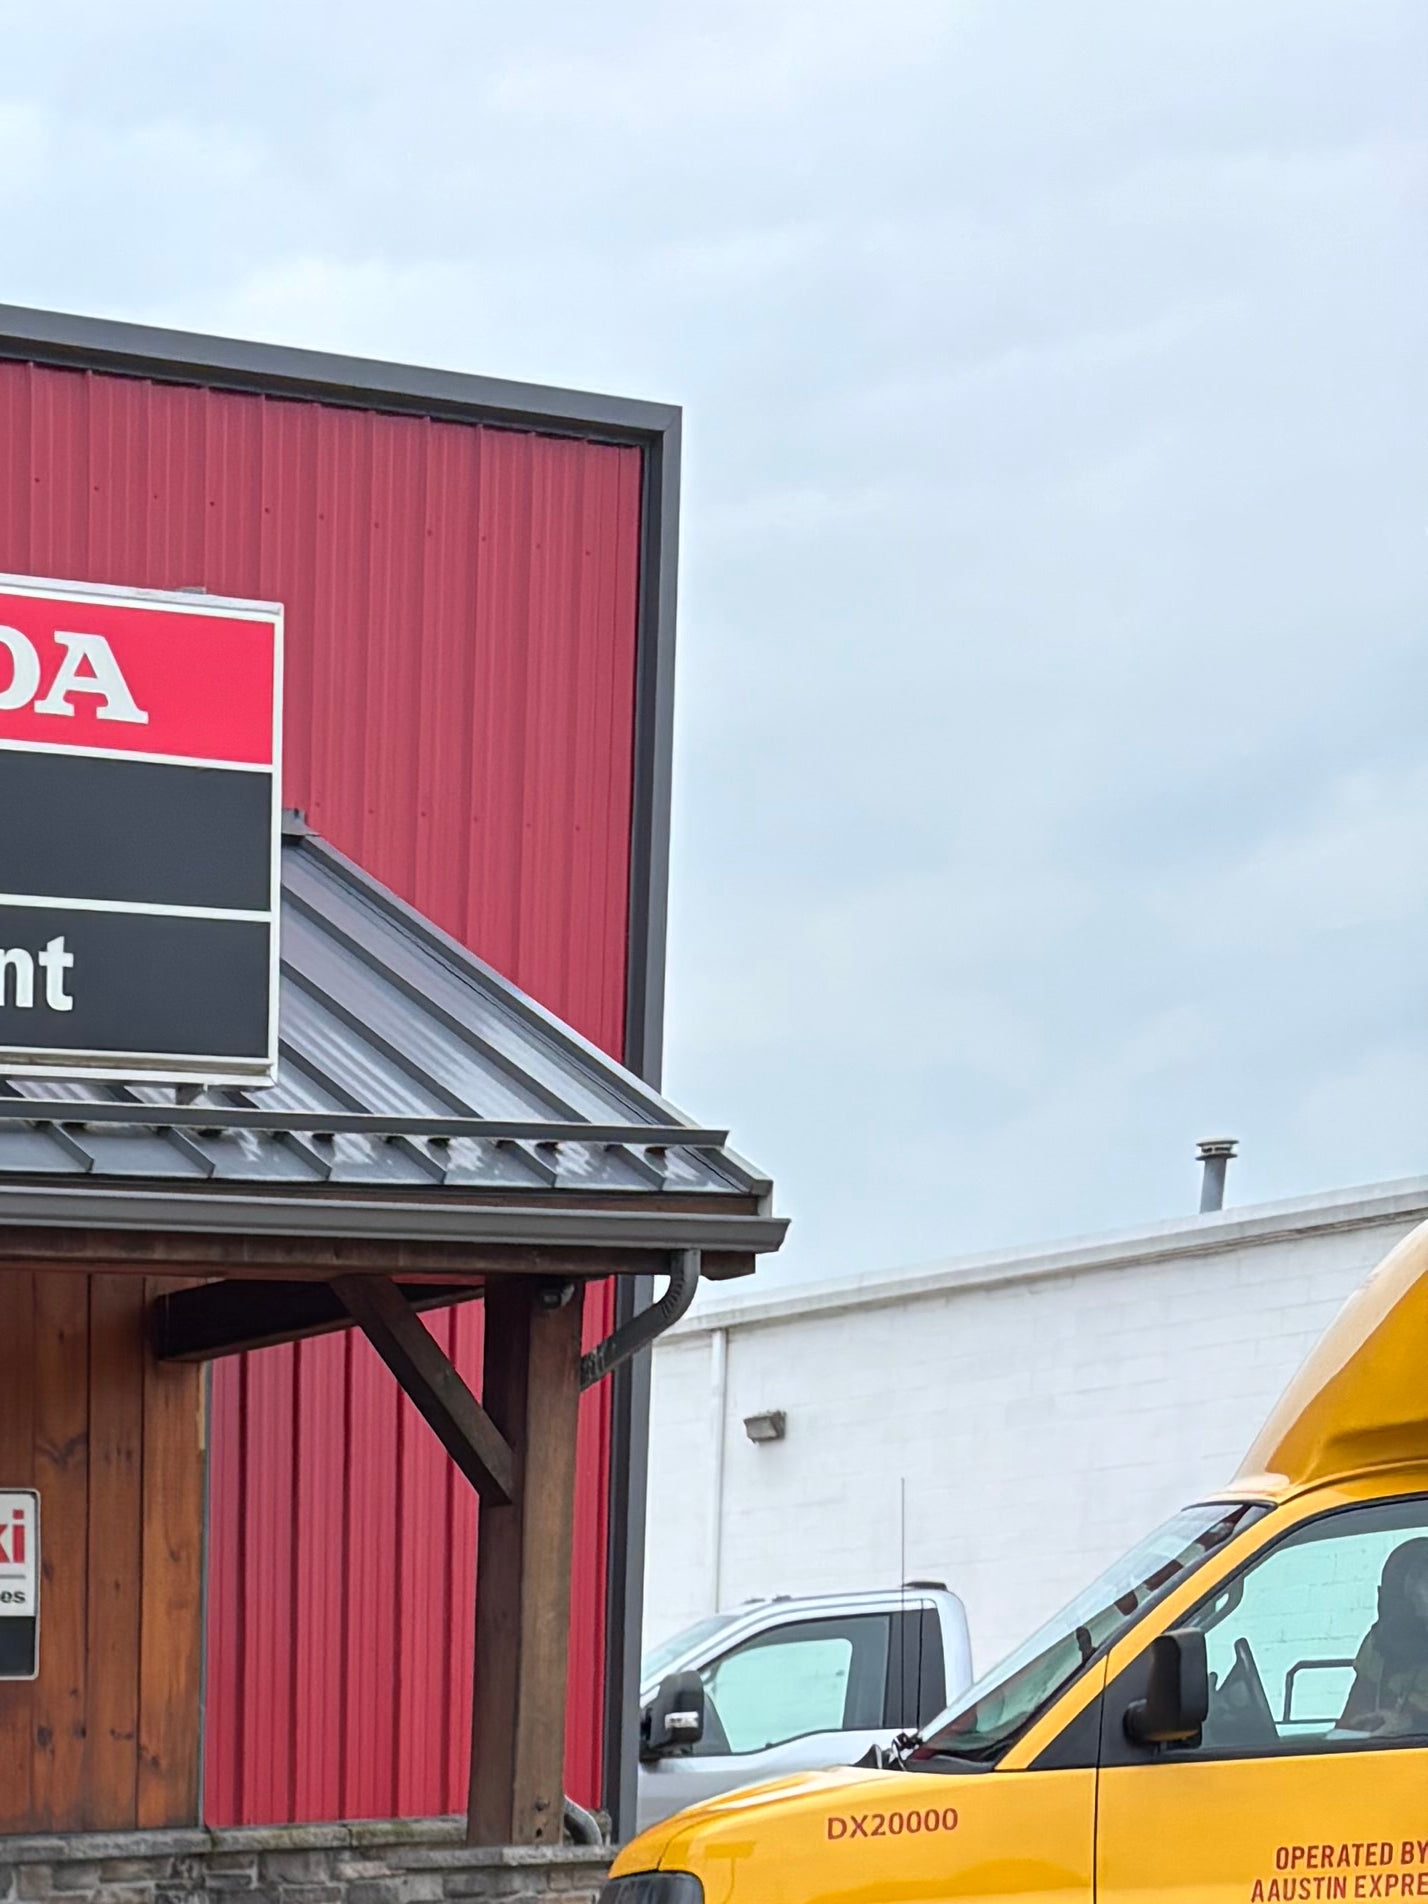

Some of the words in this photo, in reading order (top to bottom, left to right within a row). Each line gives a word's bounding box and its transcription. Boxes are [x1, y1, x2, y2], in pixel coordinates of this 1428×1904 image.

[827, 1808, 959, 1840] DX20000
[1276, 1842, 1394, 1871] OPERATED
[1401, 1840, 1428, 1866] BY
[1251, 1876, 1348, 1904] AAUSTIN
